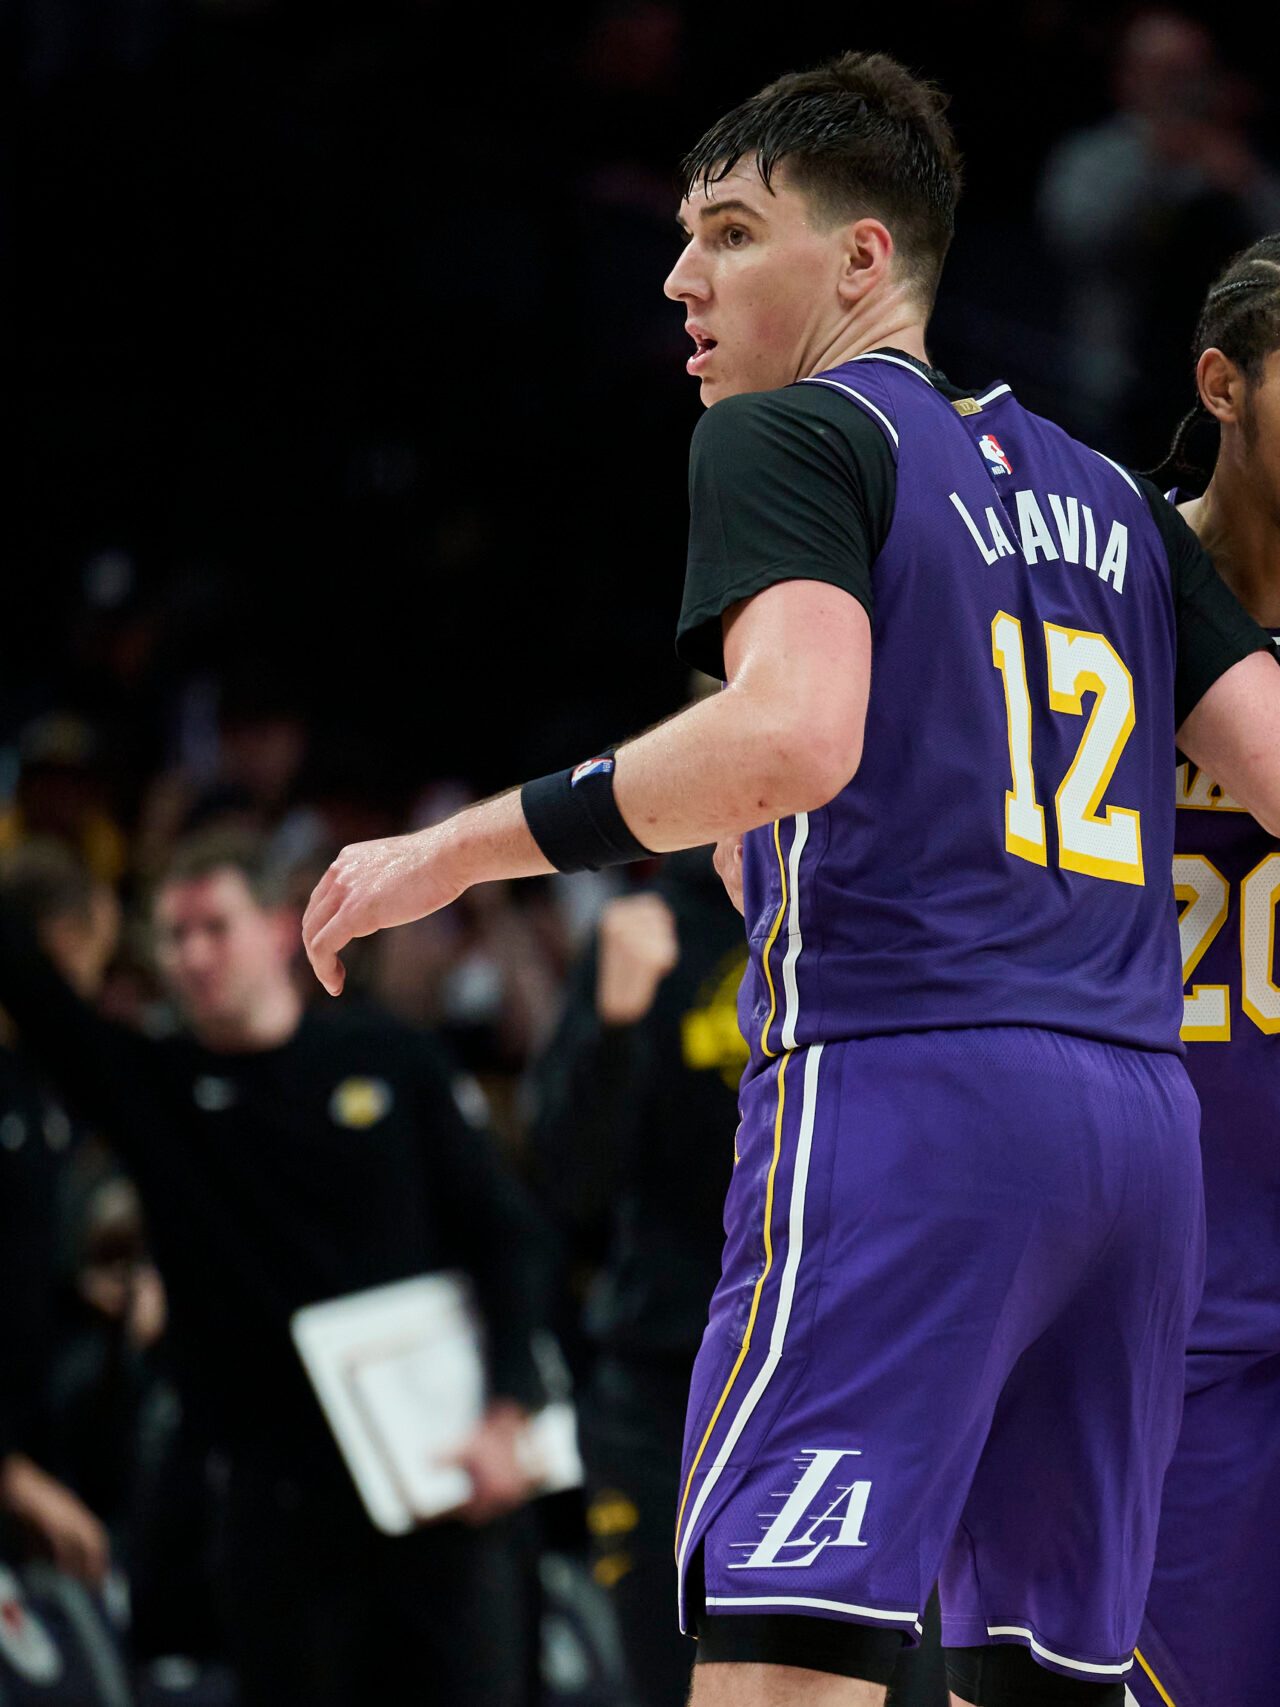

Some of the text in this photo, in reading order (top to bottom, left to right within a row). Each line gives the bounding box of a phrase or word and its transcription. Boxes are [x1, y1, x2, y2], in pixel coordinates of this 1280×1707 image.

[949, 489, 1128, 594] LAAVIA
[991, 610, 1146, 886] 12
[727, 1449, 872, 1568] LA
